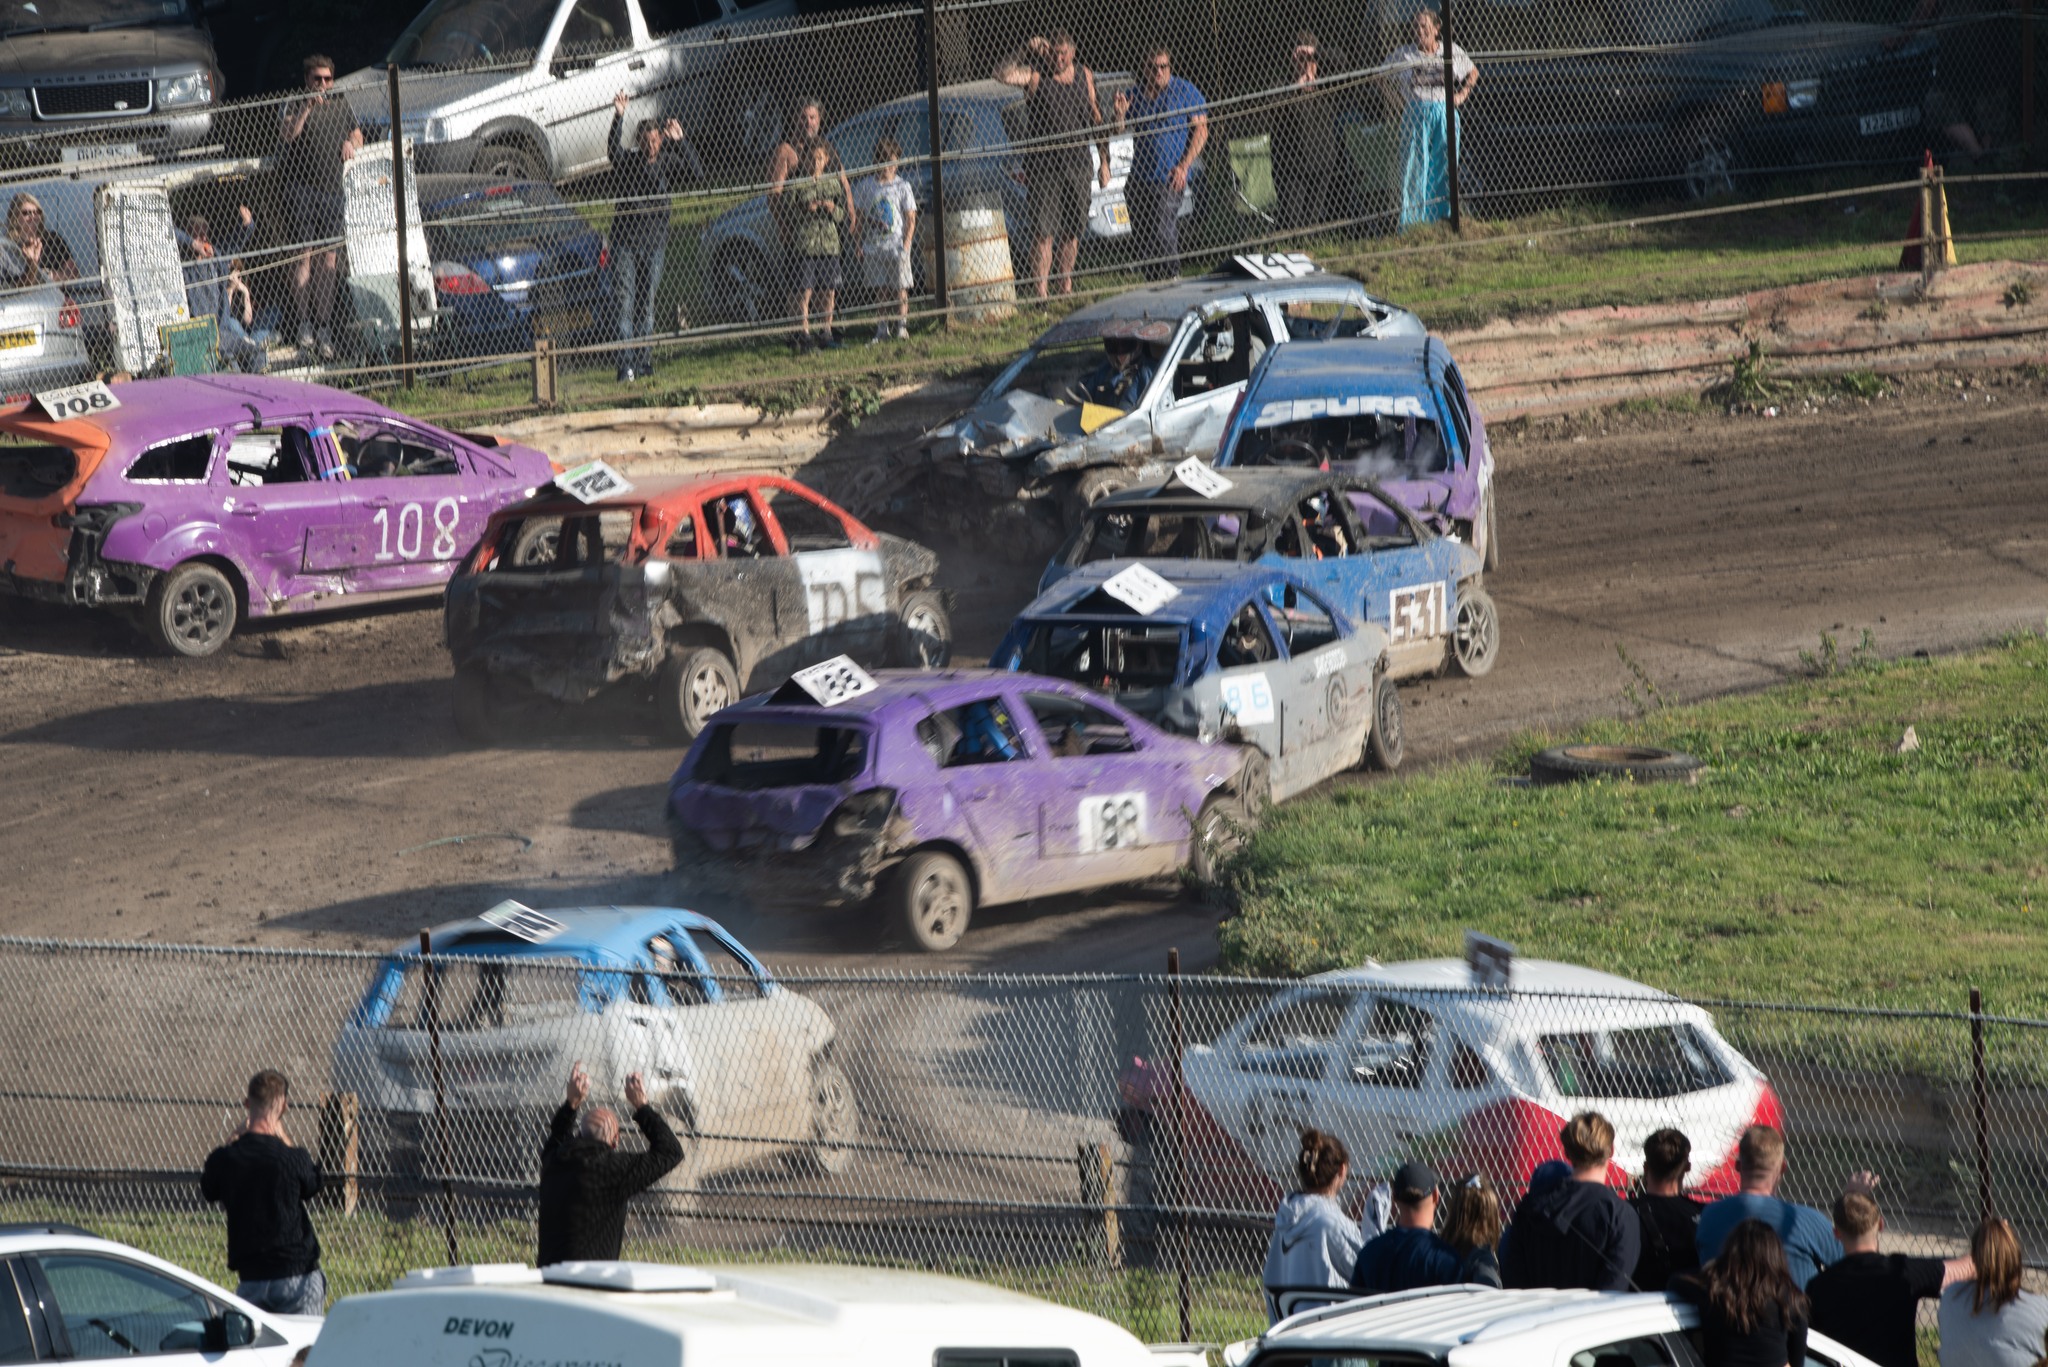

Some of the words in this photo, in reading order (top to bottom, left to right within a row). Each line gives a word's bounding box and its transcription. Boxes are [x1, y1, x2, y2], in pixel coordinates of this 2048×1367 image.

[53, 392, 112, 417] 108
[1254, 395, 1427, 428] SPURR
[373, 496, 460, 561] 108
[1393, 585, 1443, 643] 531
[443, 1316, 515, 1340] DEVON
